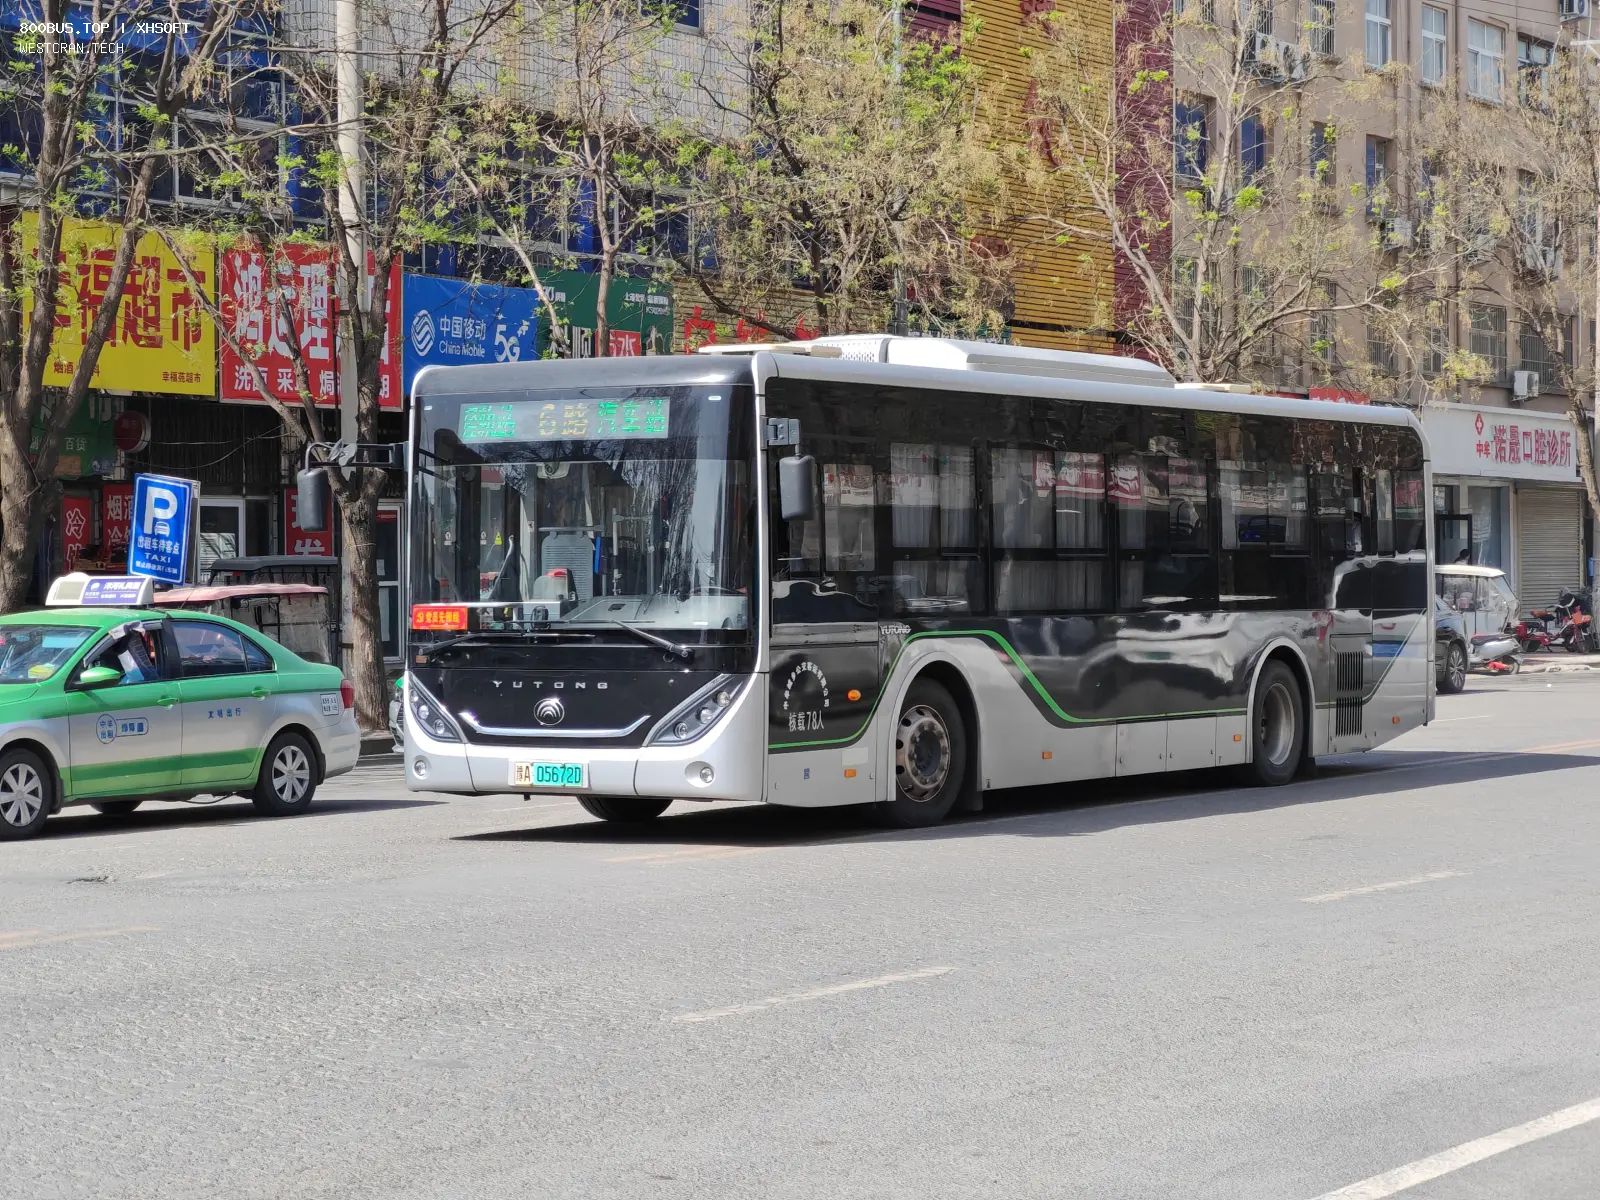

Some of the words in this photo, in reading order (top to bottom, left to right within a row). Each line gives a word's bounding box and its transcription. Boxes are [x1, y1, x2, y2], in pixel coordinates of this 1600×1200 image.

[440, 314, 487, 341] 中国移动
[439, 340, 461, 354] China
[461, 342, 486, 358] Mobile
[494, 324, 520, 362] 5G
[161, 371, 202, 384] 幸福苑超市
[277, 368, 311, 394] 采
[143, 486, 178, 534] P
[137, 535, 180, 555] 出租车待客点
[144, 552, 171, 563] TAXI
[492, 680, 608, 690] YUTONG
